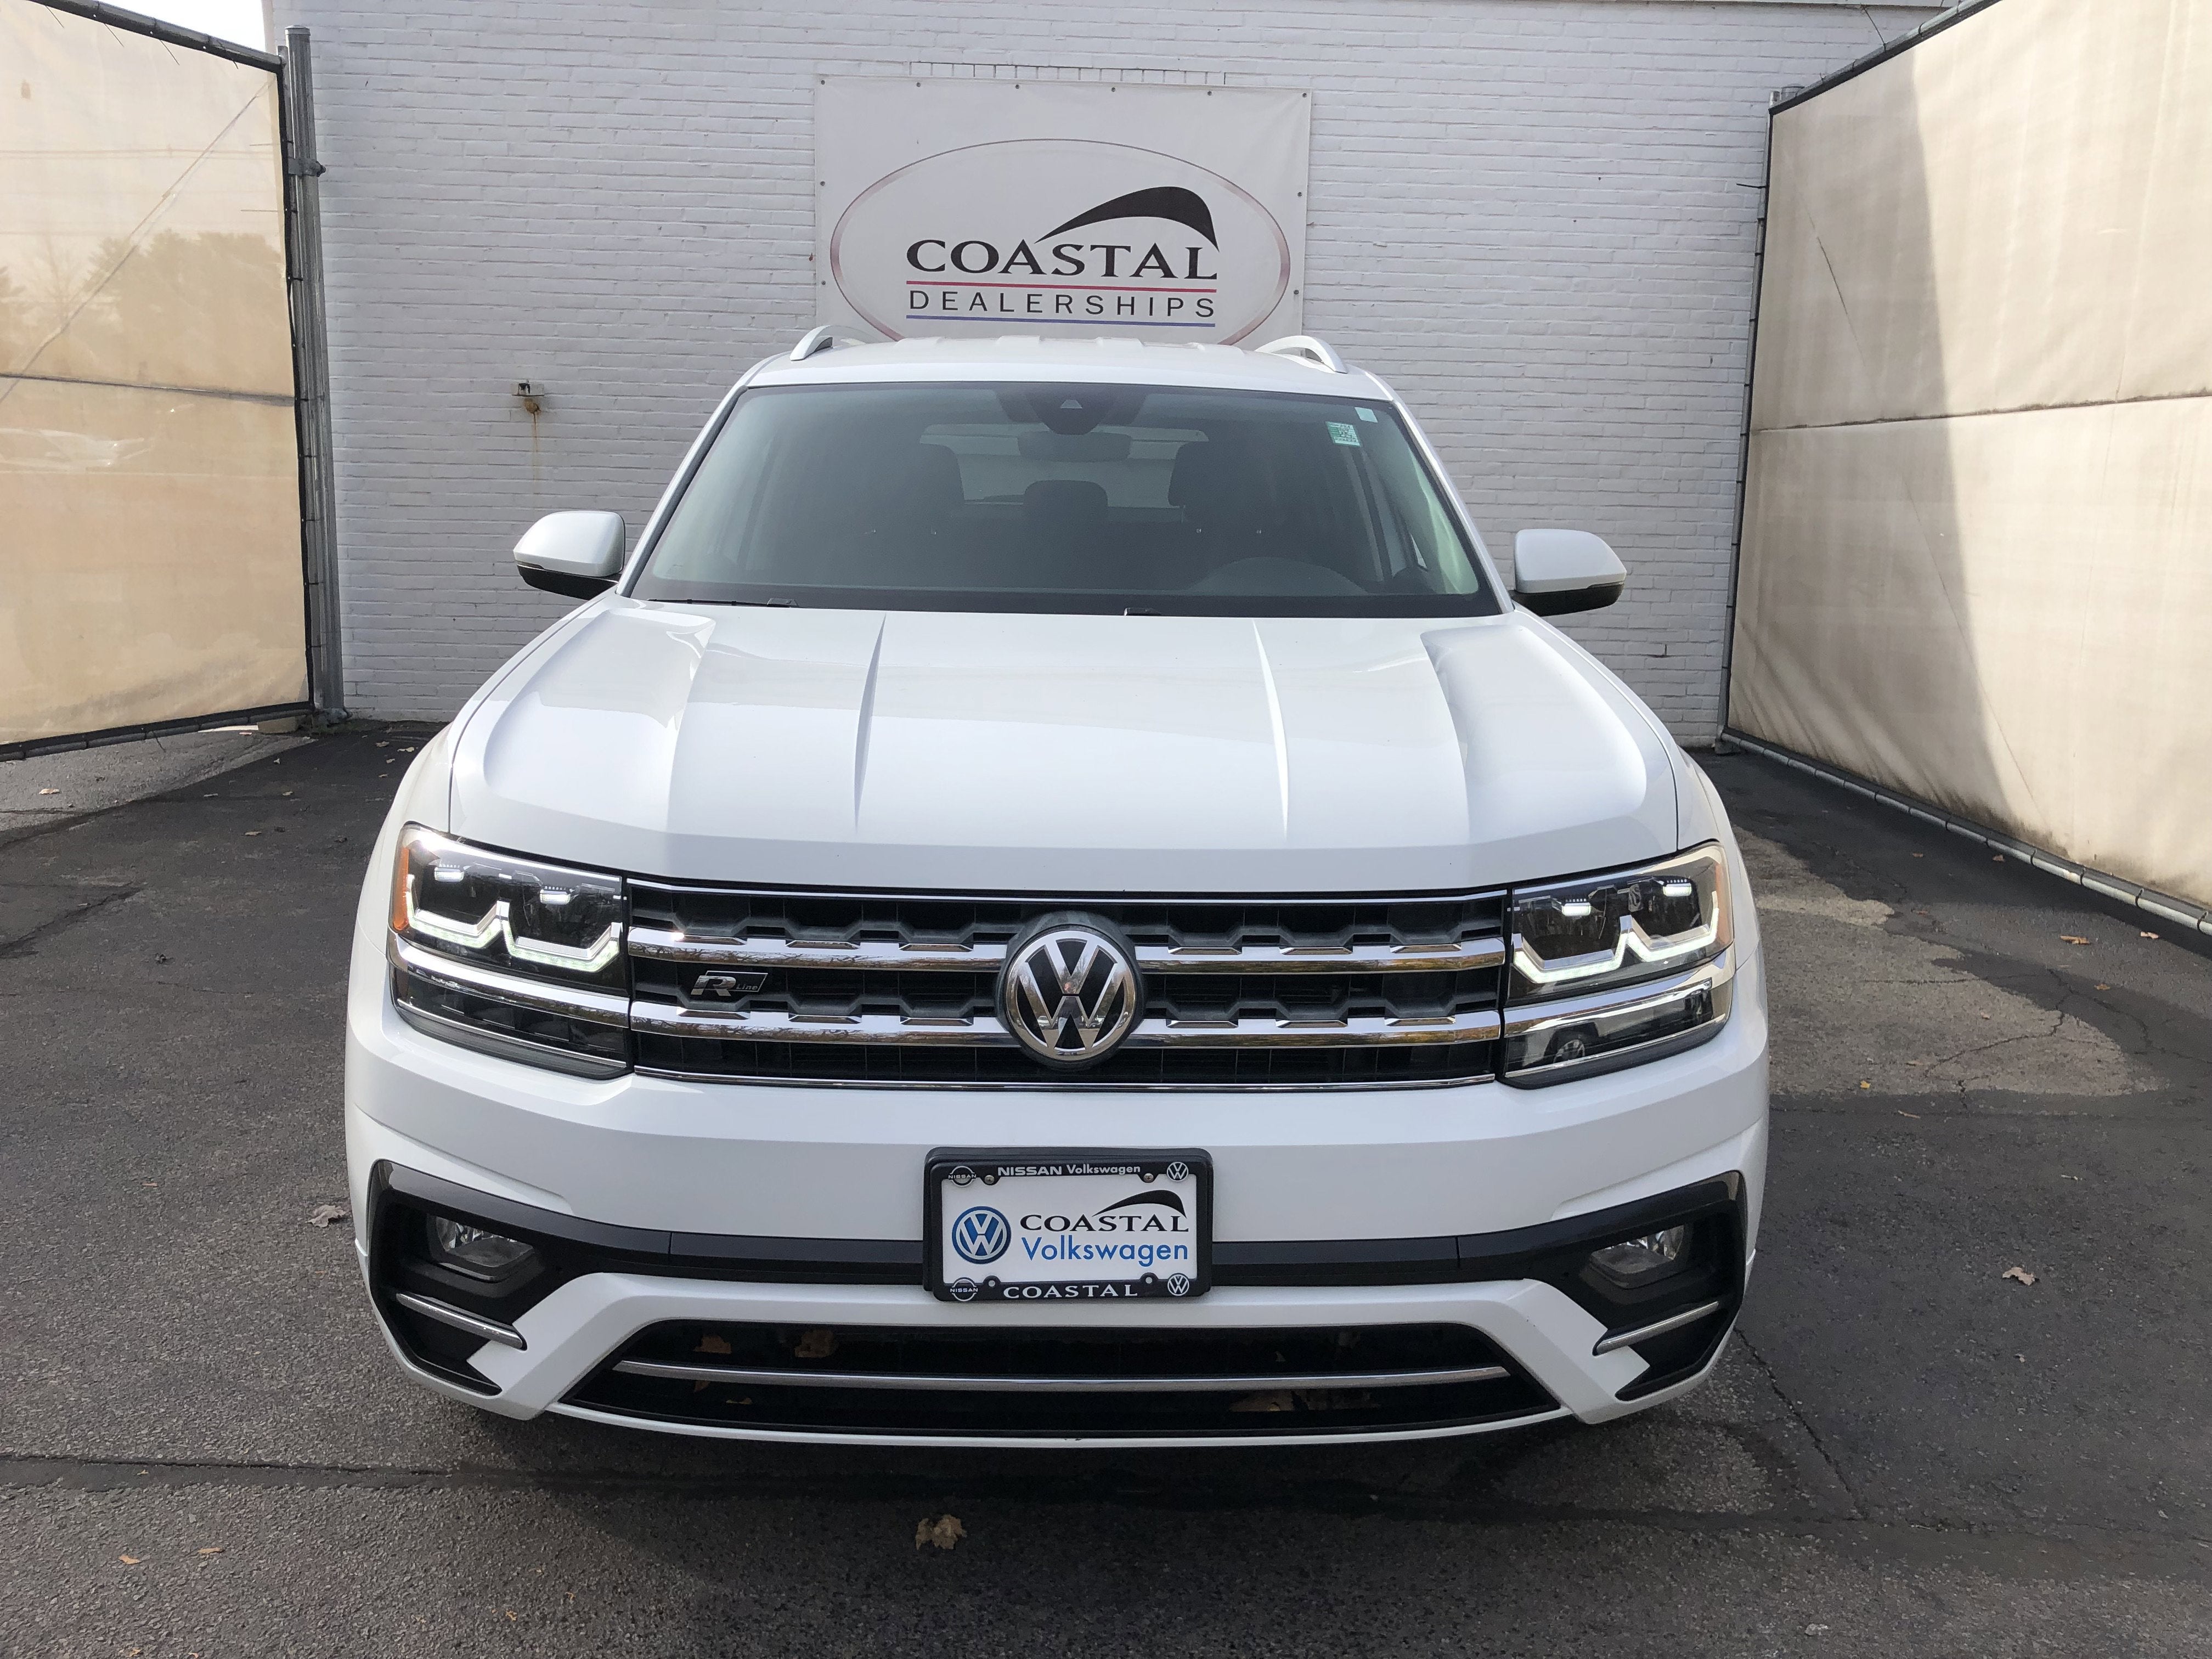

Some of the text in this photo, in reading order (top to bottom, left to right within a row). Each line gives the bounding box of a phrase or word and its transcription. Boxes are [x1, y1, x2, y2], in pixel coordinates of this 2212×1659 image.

[906, 239, 1217, 280] COASTAL
[910, 290, 1215, 318] DEALERSHIPS
[691, 975, 736, 996] R
[998, 1164, 1141, 1176] NISSAN Volkswagen
[1020, 1214, 1189, 1232] COASTAL
[1021, 1234, 1188, 1267] Volkswagen
[1003, 1284, 1138, 1299] COASTAL
